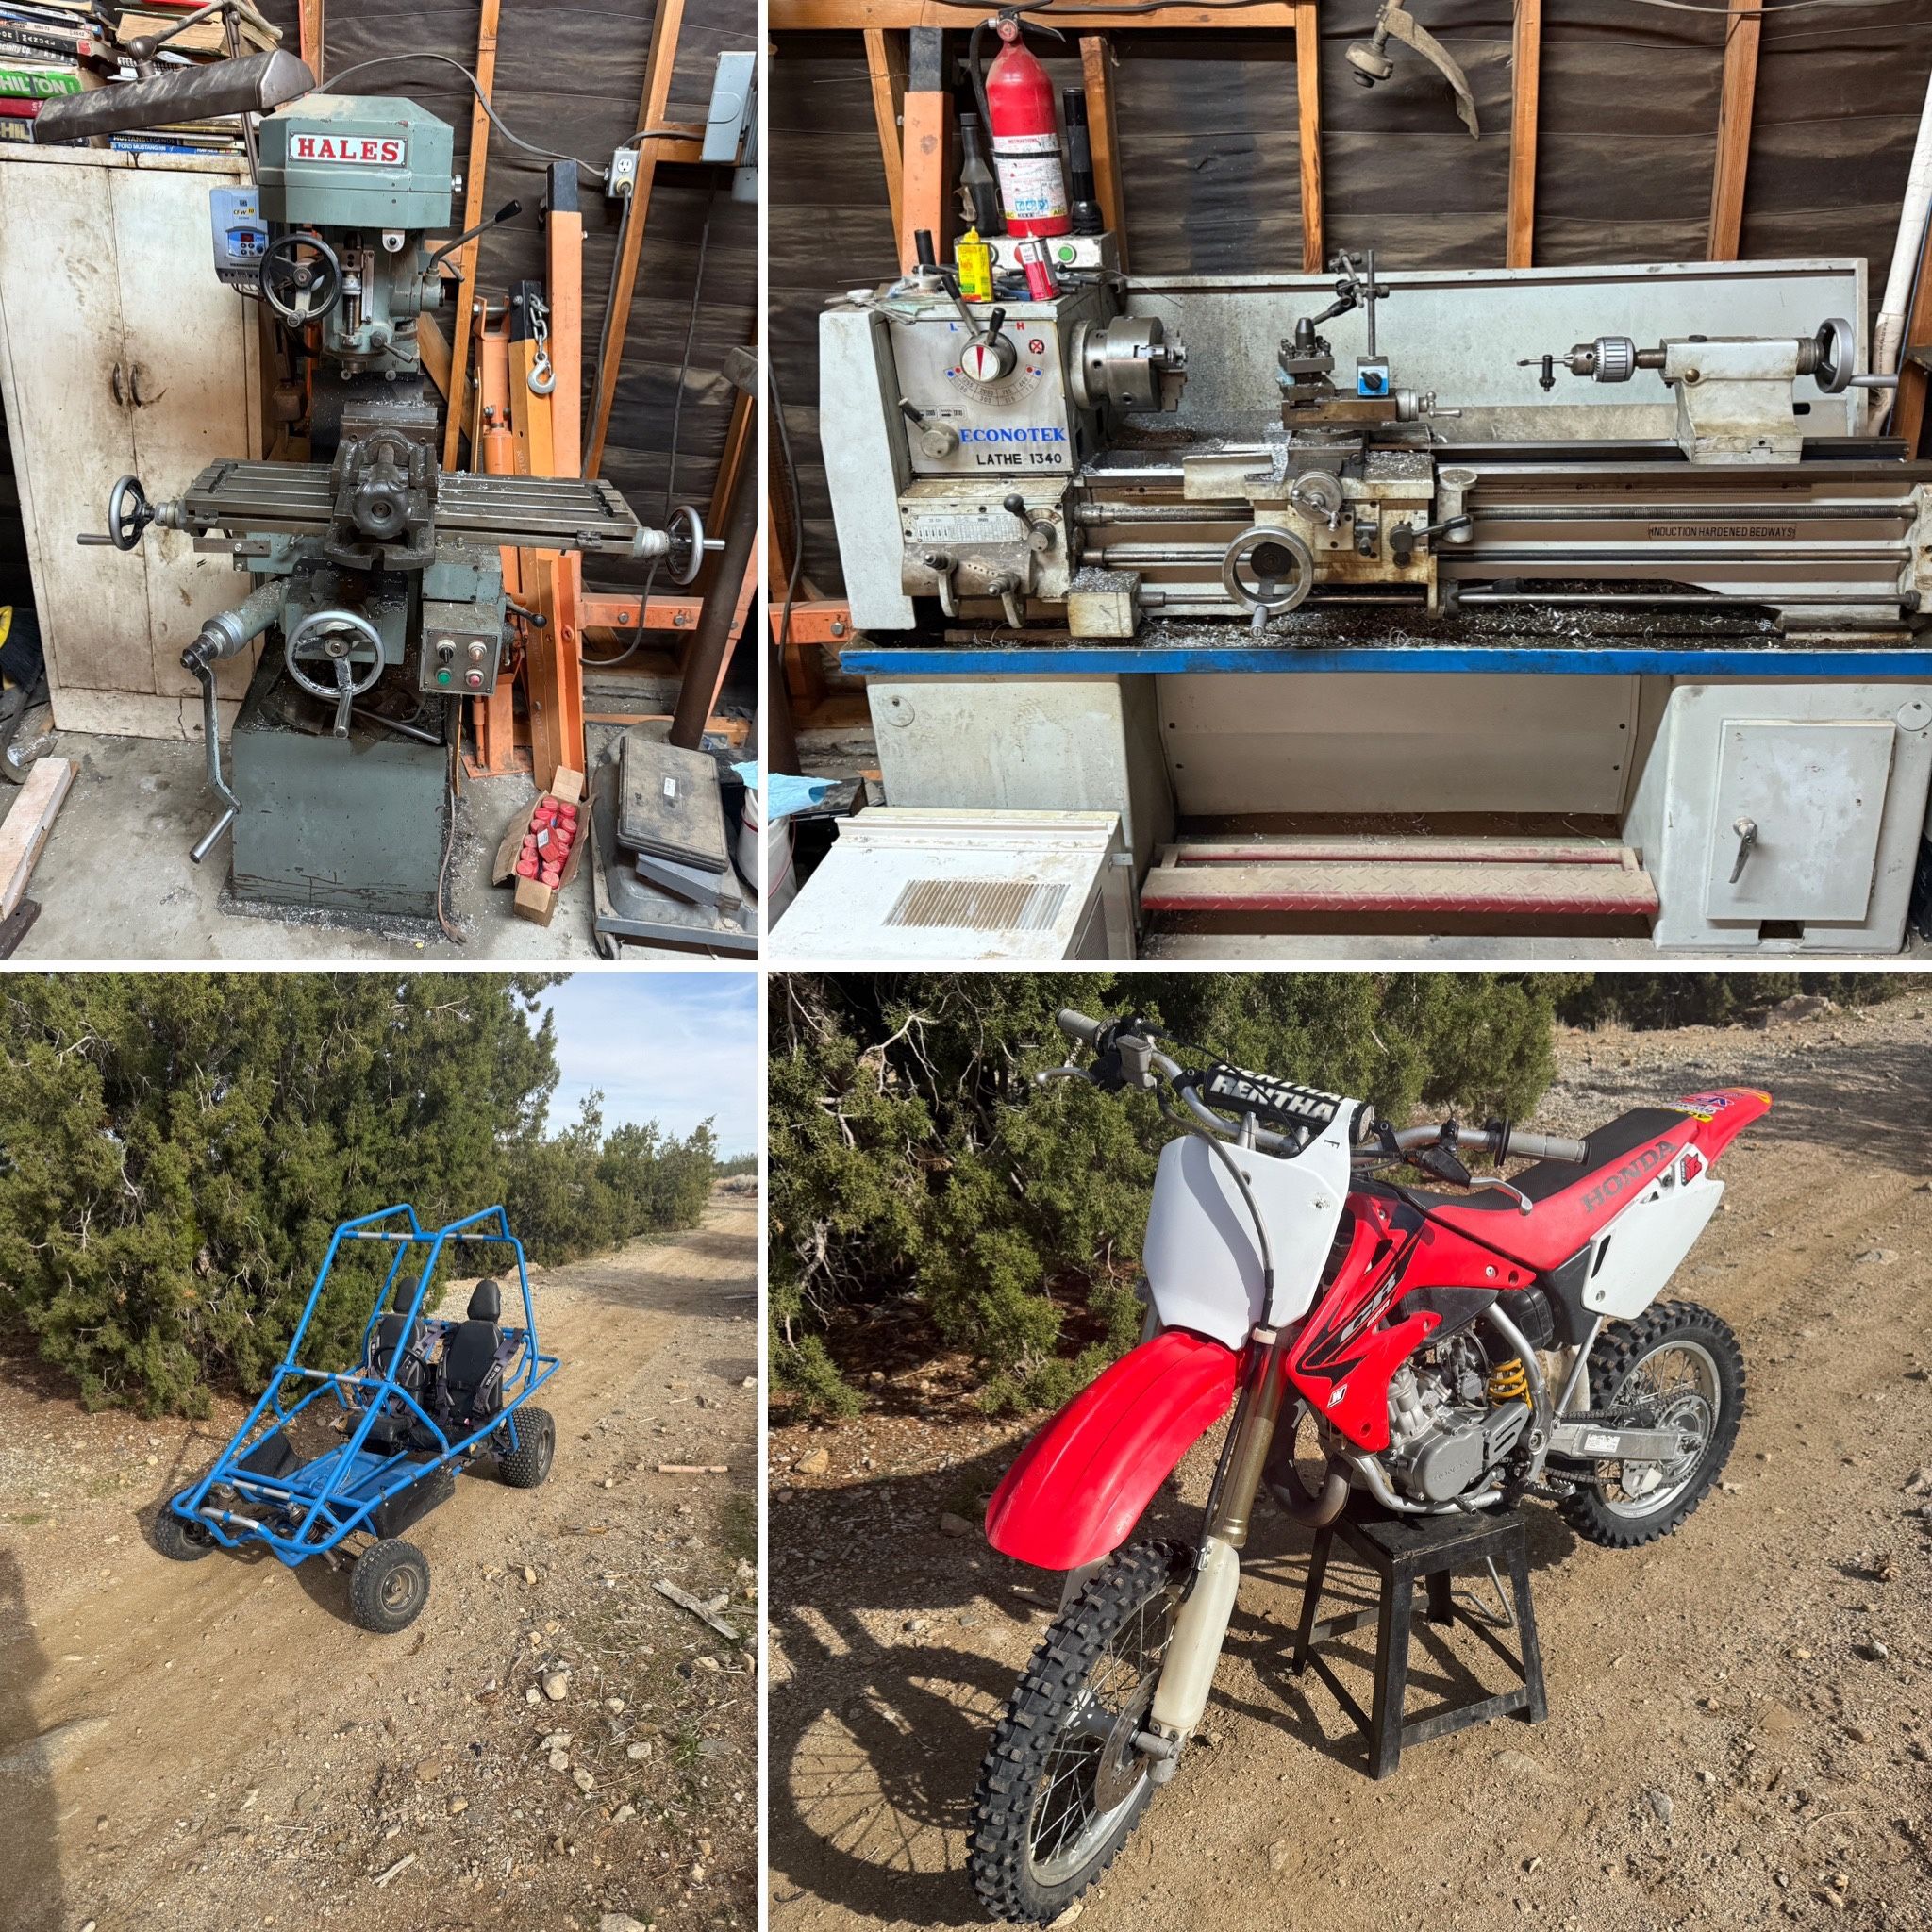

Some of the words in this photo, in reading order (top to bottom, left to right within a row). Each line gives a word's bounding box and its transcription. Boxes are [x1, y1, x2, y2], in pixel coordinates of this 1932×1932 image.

[298, 137, 399, 162] HALES
[949, 323, 958, 332] L
[1016, 322, 1025, 330] H
[959, 427, 1066, 442] ECONOTEK
[977, 453, 1022, 465] LATHE
[1030, 453, 1062, 464] 1340
[1652, 527, 1696, 537] INDUCTION
[1699, 527, 1747, 537] HARDENED
[1749, 527, 1792, 537] BEDWAYS
[1210, 1074, 1336, 1123] RENTHA
[1579, 1140, 1679, 1213] HONDA
